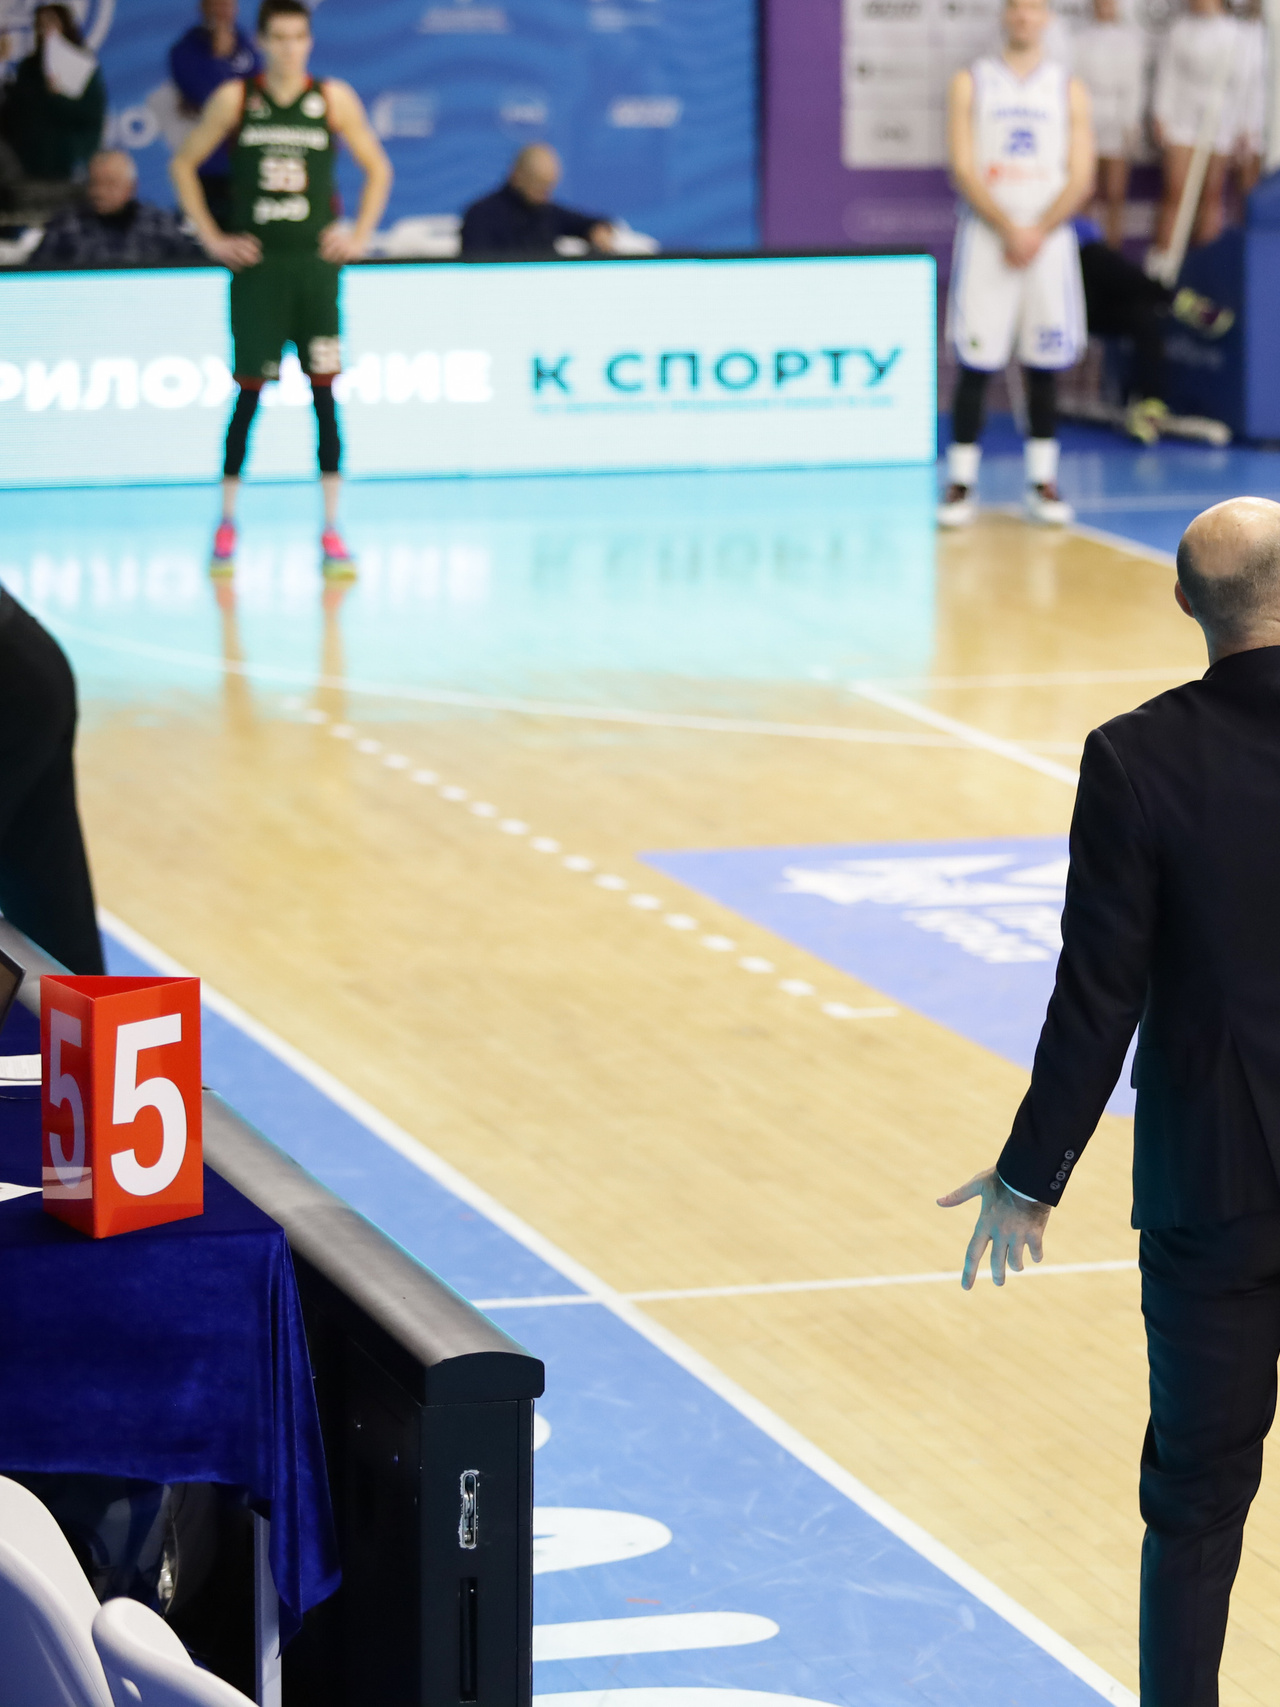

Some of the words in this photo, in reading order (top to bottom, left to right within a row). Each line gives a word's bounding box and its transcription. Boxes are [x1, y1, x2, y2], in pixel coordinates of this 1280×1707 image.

[532, 352, 572, 395] К
[604, 346, 902, 393] СПОРТУ
[49, 1008, 85, 1189] 5
[111, 1013, 187, 1196] 5
